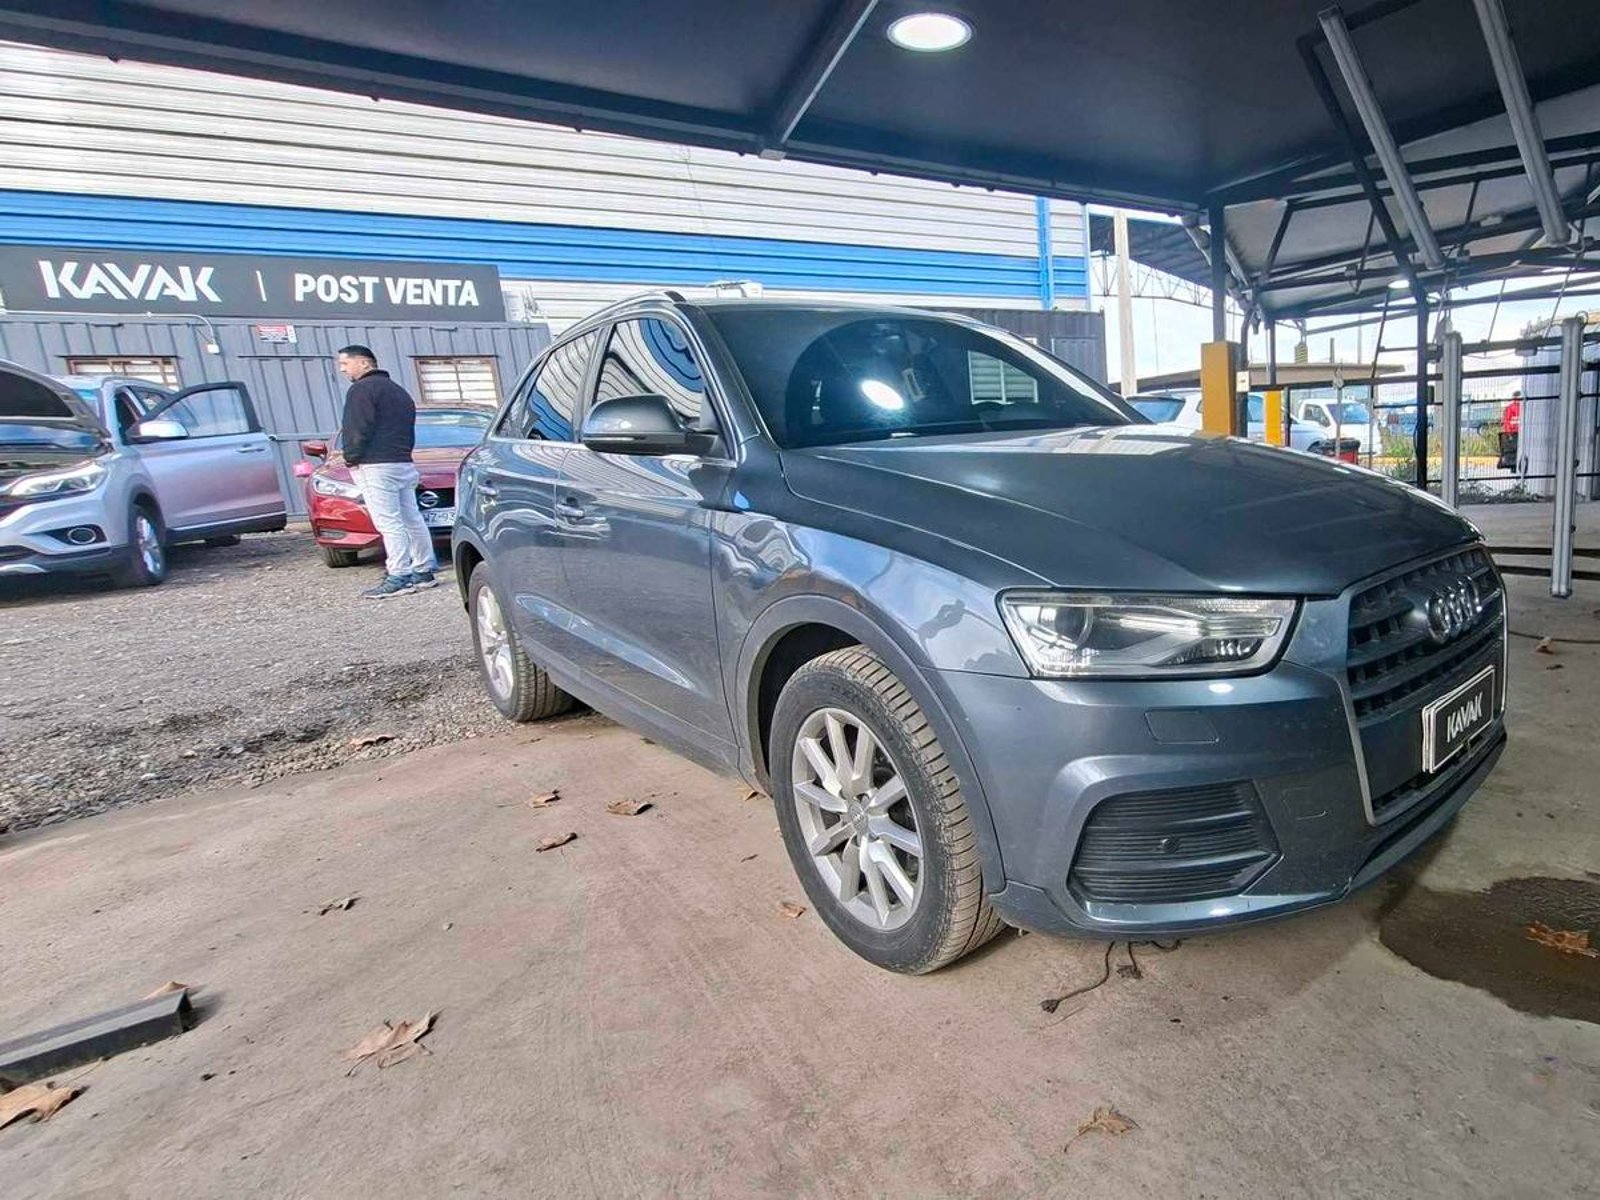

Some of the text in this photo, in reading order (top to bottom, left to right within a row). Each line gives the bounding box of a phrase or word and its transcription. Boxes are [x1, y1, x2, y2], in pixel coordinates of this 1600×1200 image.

[38, 260, 222, 302] KAVAK
[294, 273, 379, 304] POST
[385, 277, 479, 306] VENTA
[1447, 691, 1483, 743] KAVAK
